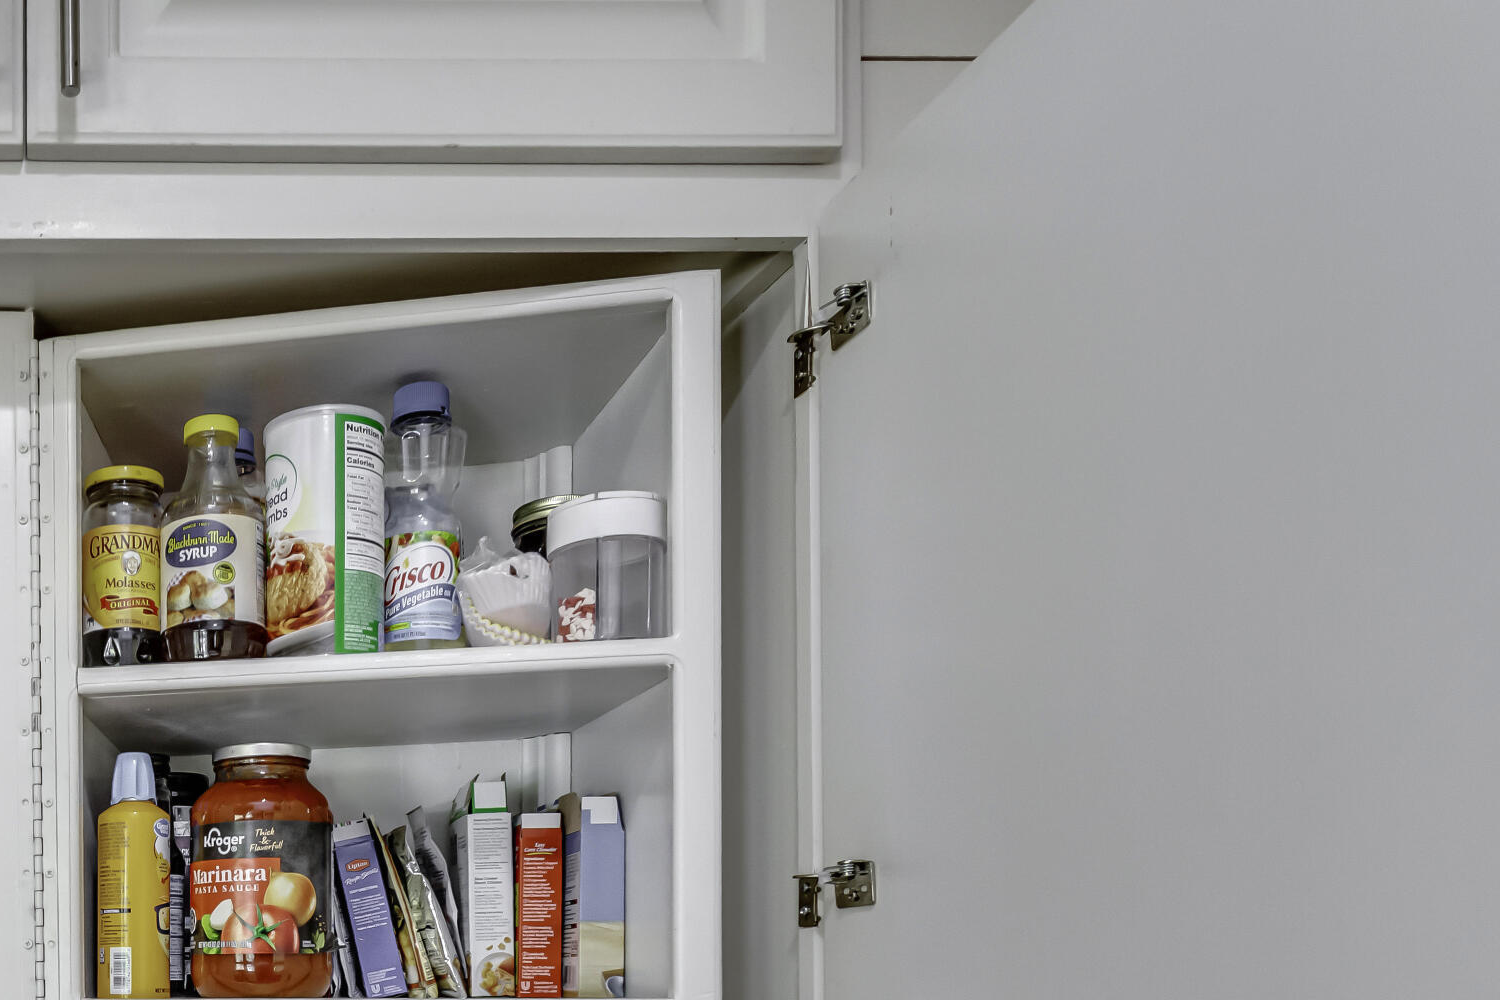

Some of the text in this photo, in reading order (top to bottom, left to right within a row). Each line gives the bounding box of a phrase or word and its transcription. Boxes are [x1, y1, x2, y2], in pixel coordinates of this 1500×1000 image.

[346, 423, 380, 440] Nutrition
[347, 456, 375, 469] Calories
[179, 545, 218, 562] SYRUP
[105, 576, 156, 591] Molasses
[384, 560, 446, 607] Crisco
[109, 600, 151, 609] ORIGINAL
[385, 586, 444, 618] Pure Vegetable
[255, 827, 275, 837] Thick
[203, 827, 245, 855] Kroger
[347, 860, 368, 870] Lipton
[193, 865, 267, 885] Marinara
[194, 883, 260, 894] PASTA SAUCE
